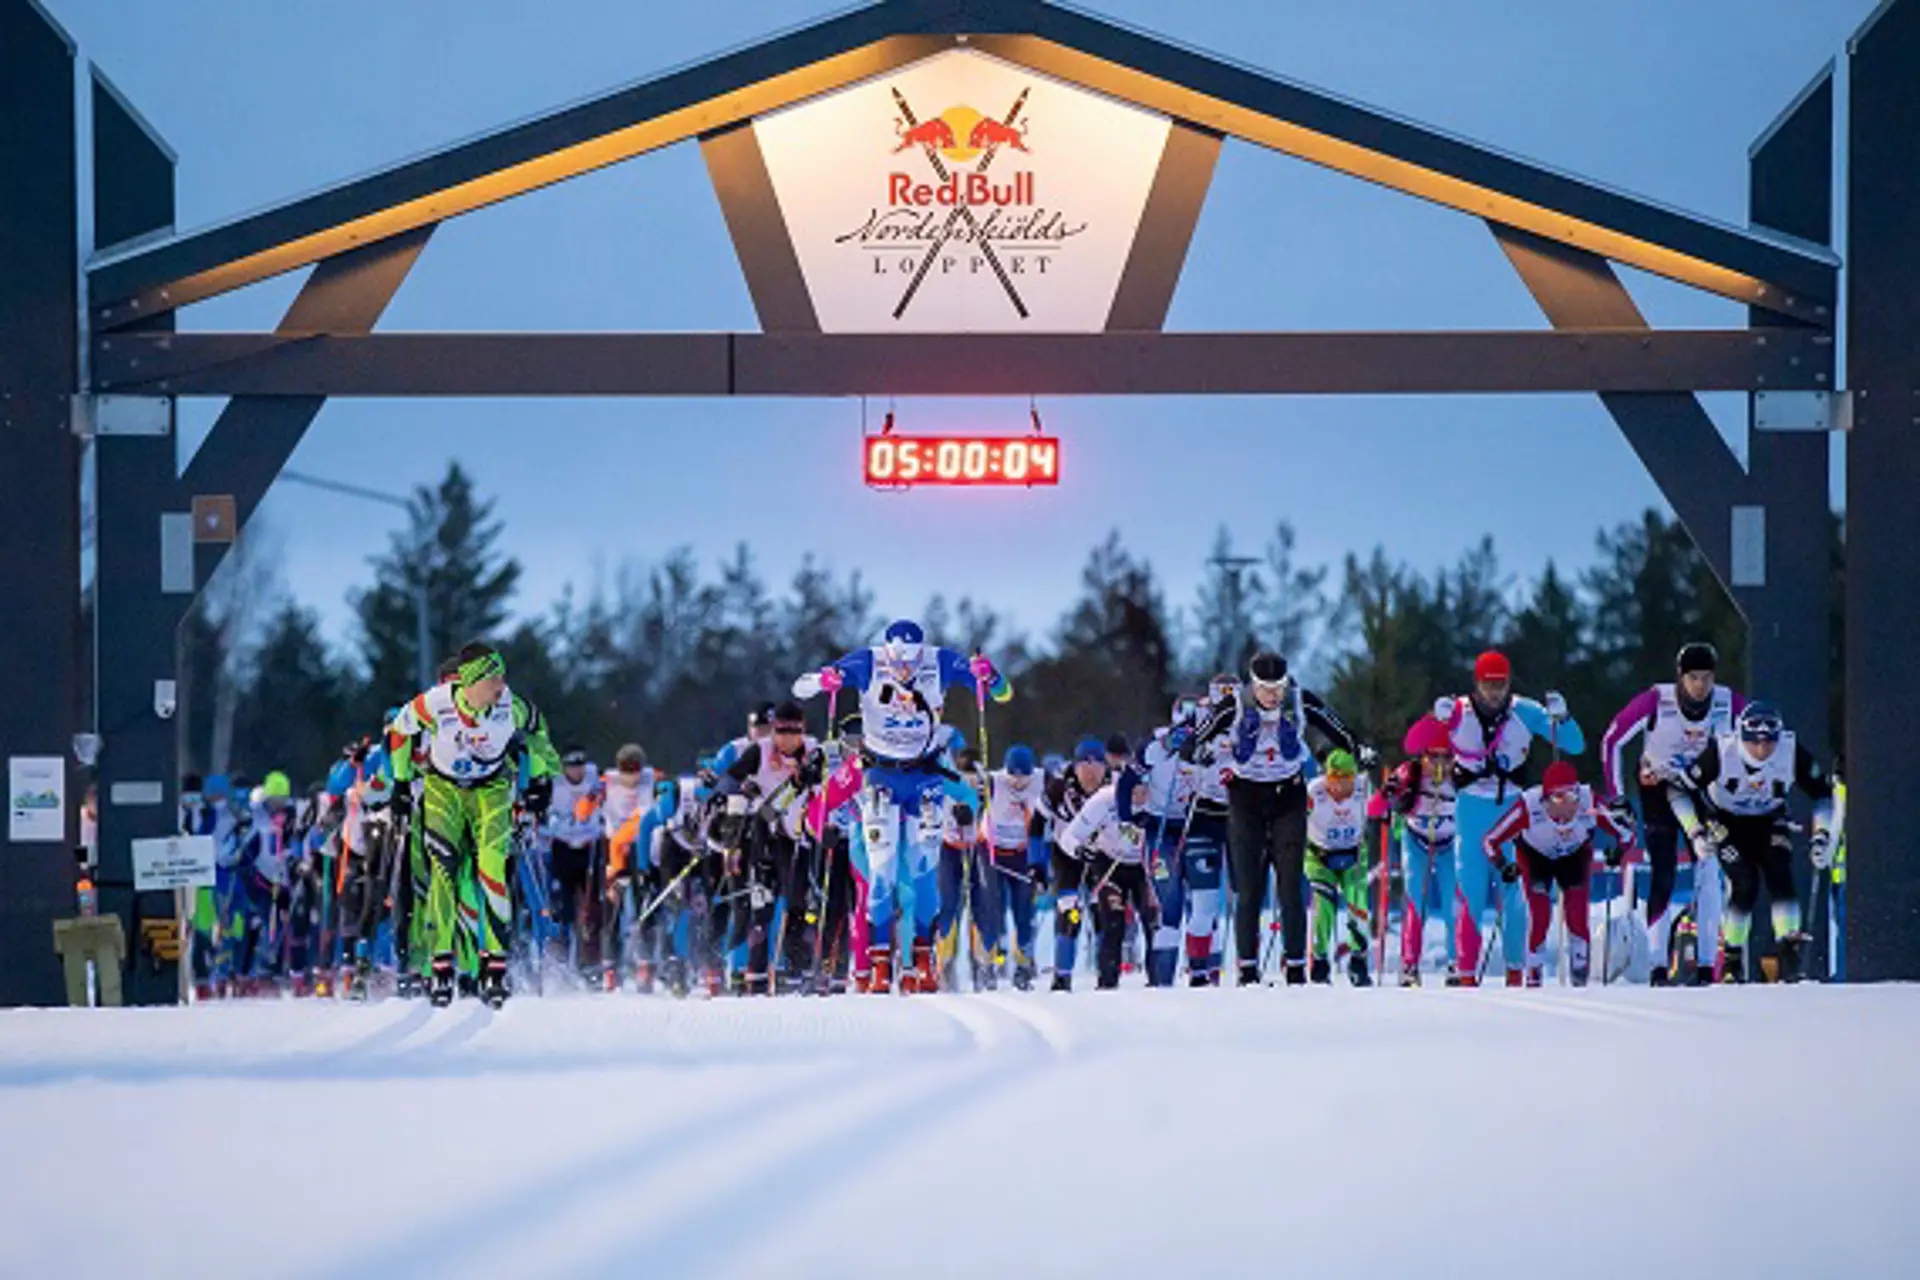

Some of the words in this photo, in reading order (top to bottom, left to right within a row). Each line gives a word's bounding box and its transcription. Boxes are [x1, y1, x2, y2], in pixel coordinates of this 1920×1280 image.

[889, 172, 957, 205] Red
[966, 171, 1033, 205] Bull
[873, 256, 1051, 273] LOPPET
[869, 441, 1055, 478] 05:00:04
